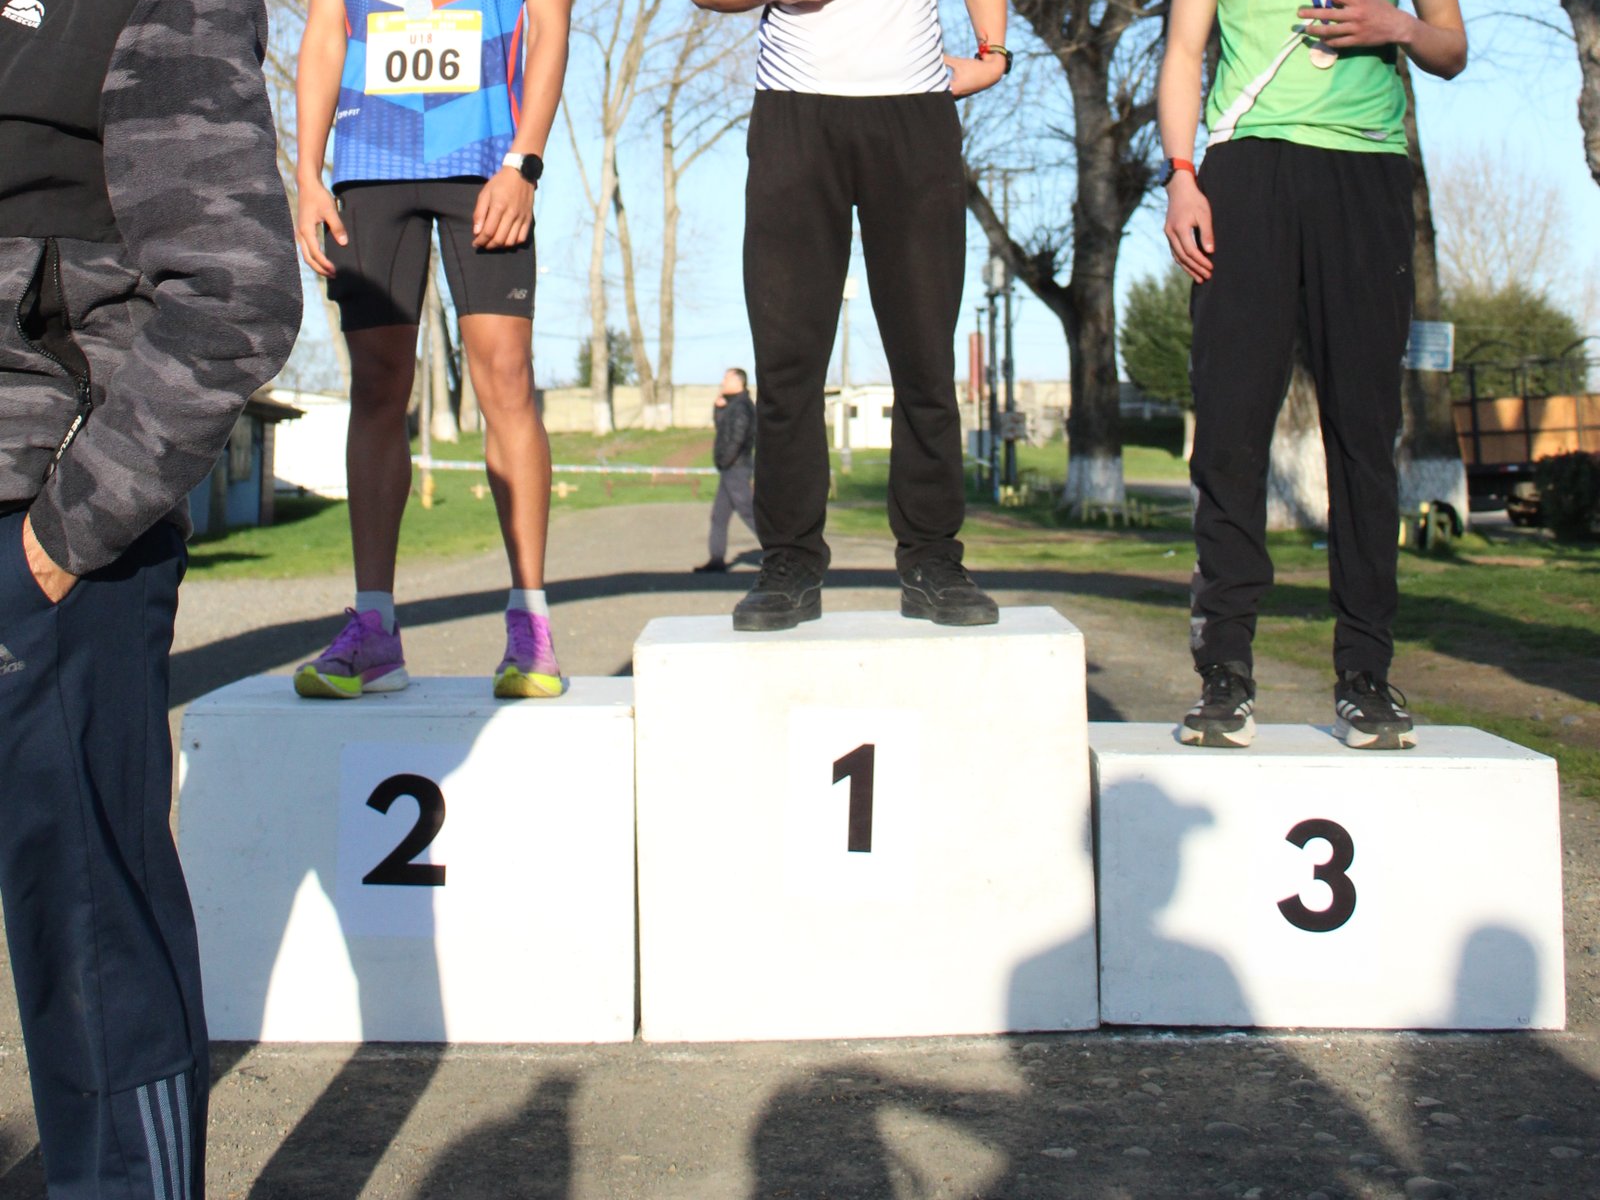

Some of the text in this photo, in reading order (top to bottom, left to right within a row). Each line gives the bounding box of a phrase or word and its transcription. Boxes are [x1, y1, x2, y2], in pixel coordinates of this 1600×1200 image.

[385, 49, 460, 83] 006
[361, 772, 446, 886] 2
[832, 743, 875, 853] 1
[1276, 818, 1357, 932] 3
